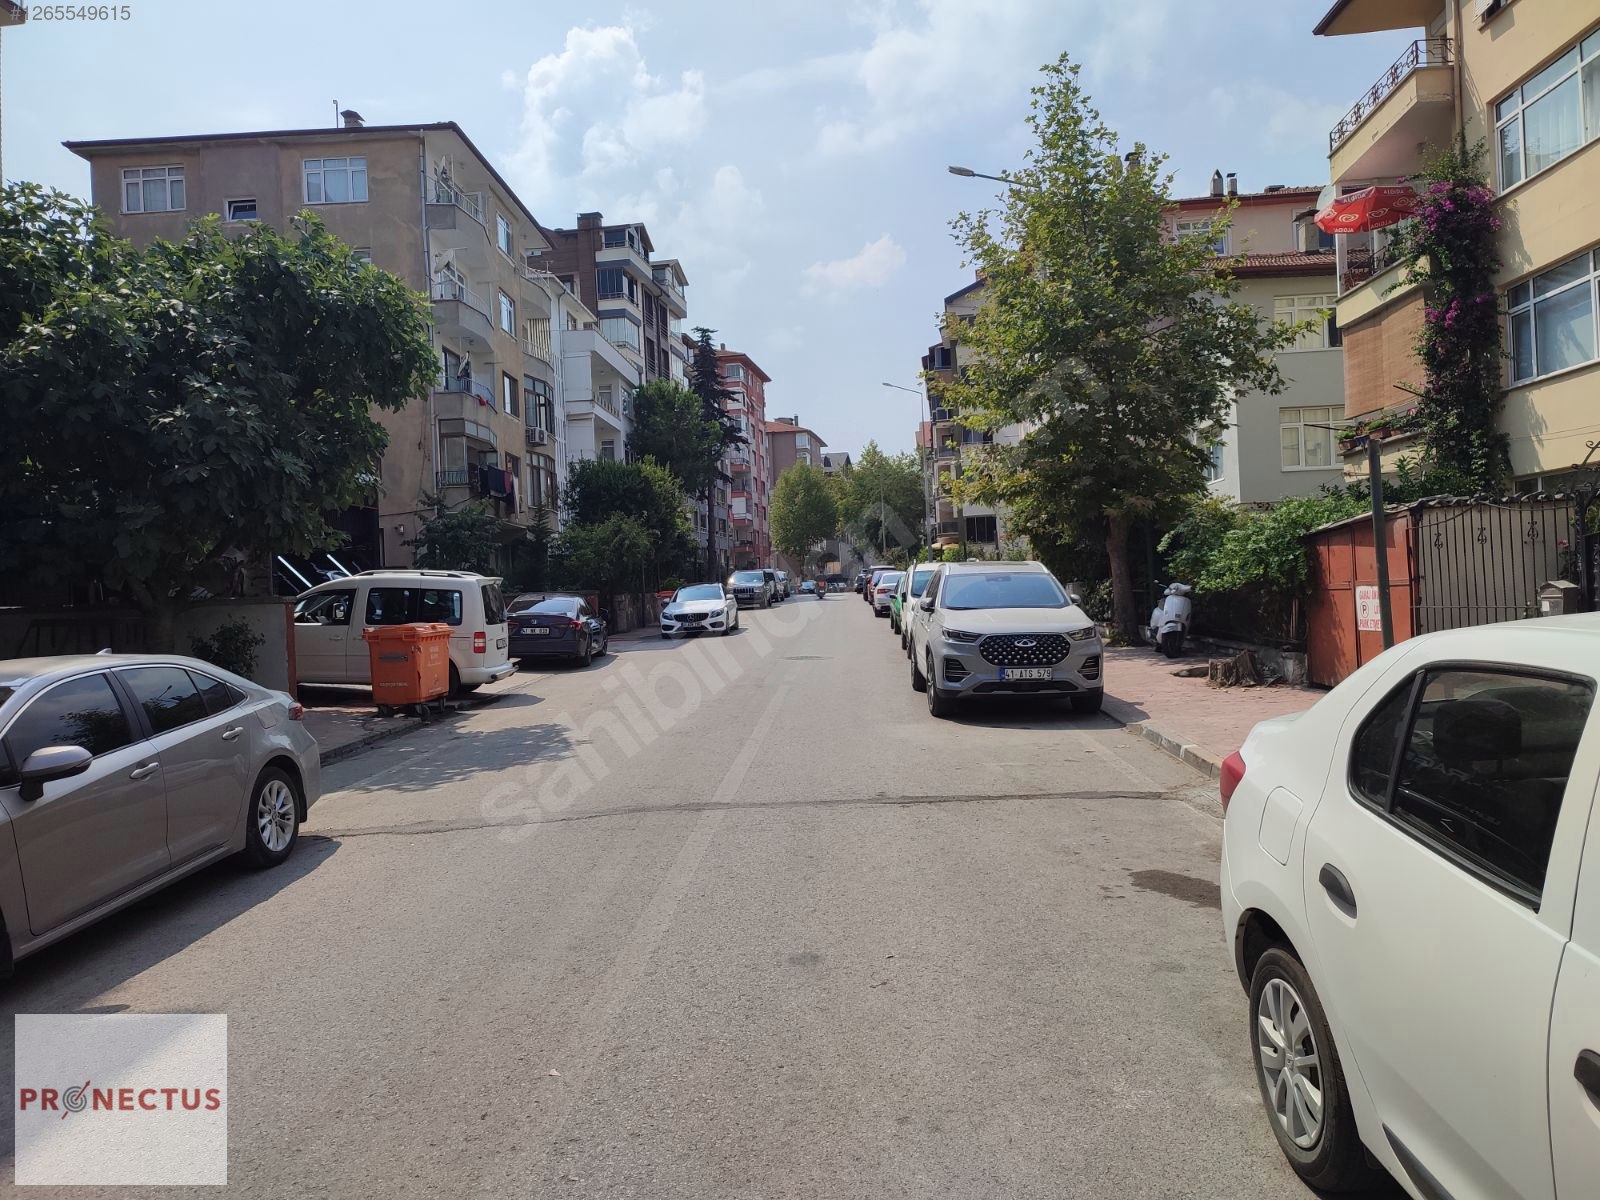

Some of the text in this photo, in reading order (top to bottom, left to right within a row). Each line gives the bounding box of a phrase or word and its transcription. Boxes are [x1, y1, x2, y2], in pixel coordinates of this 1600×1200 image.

[1005, 669, 1051, 678] 41 ATS 579
